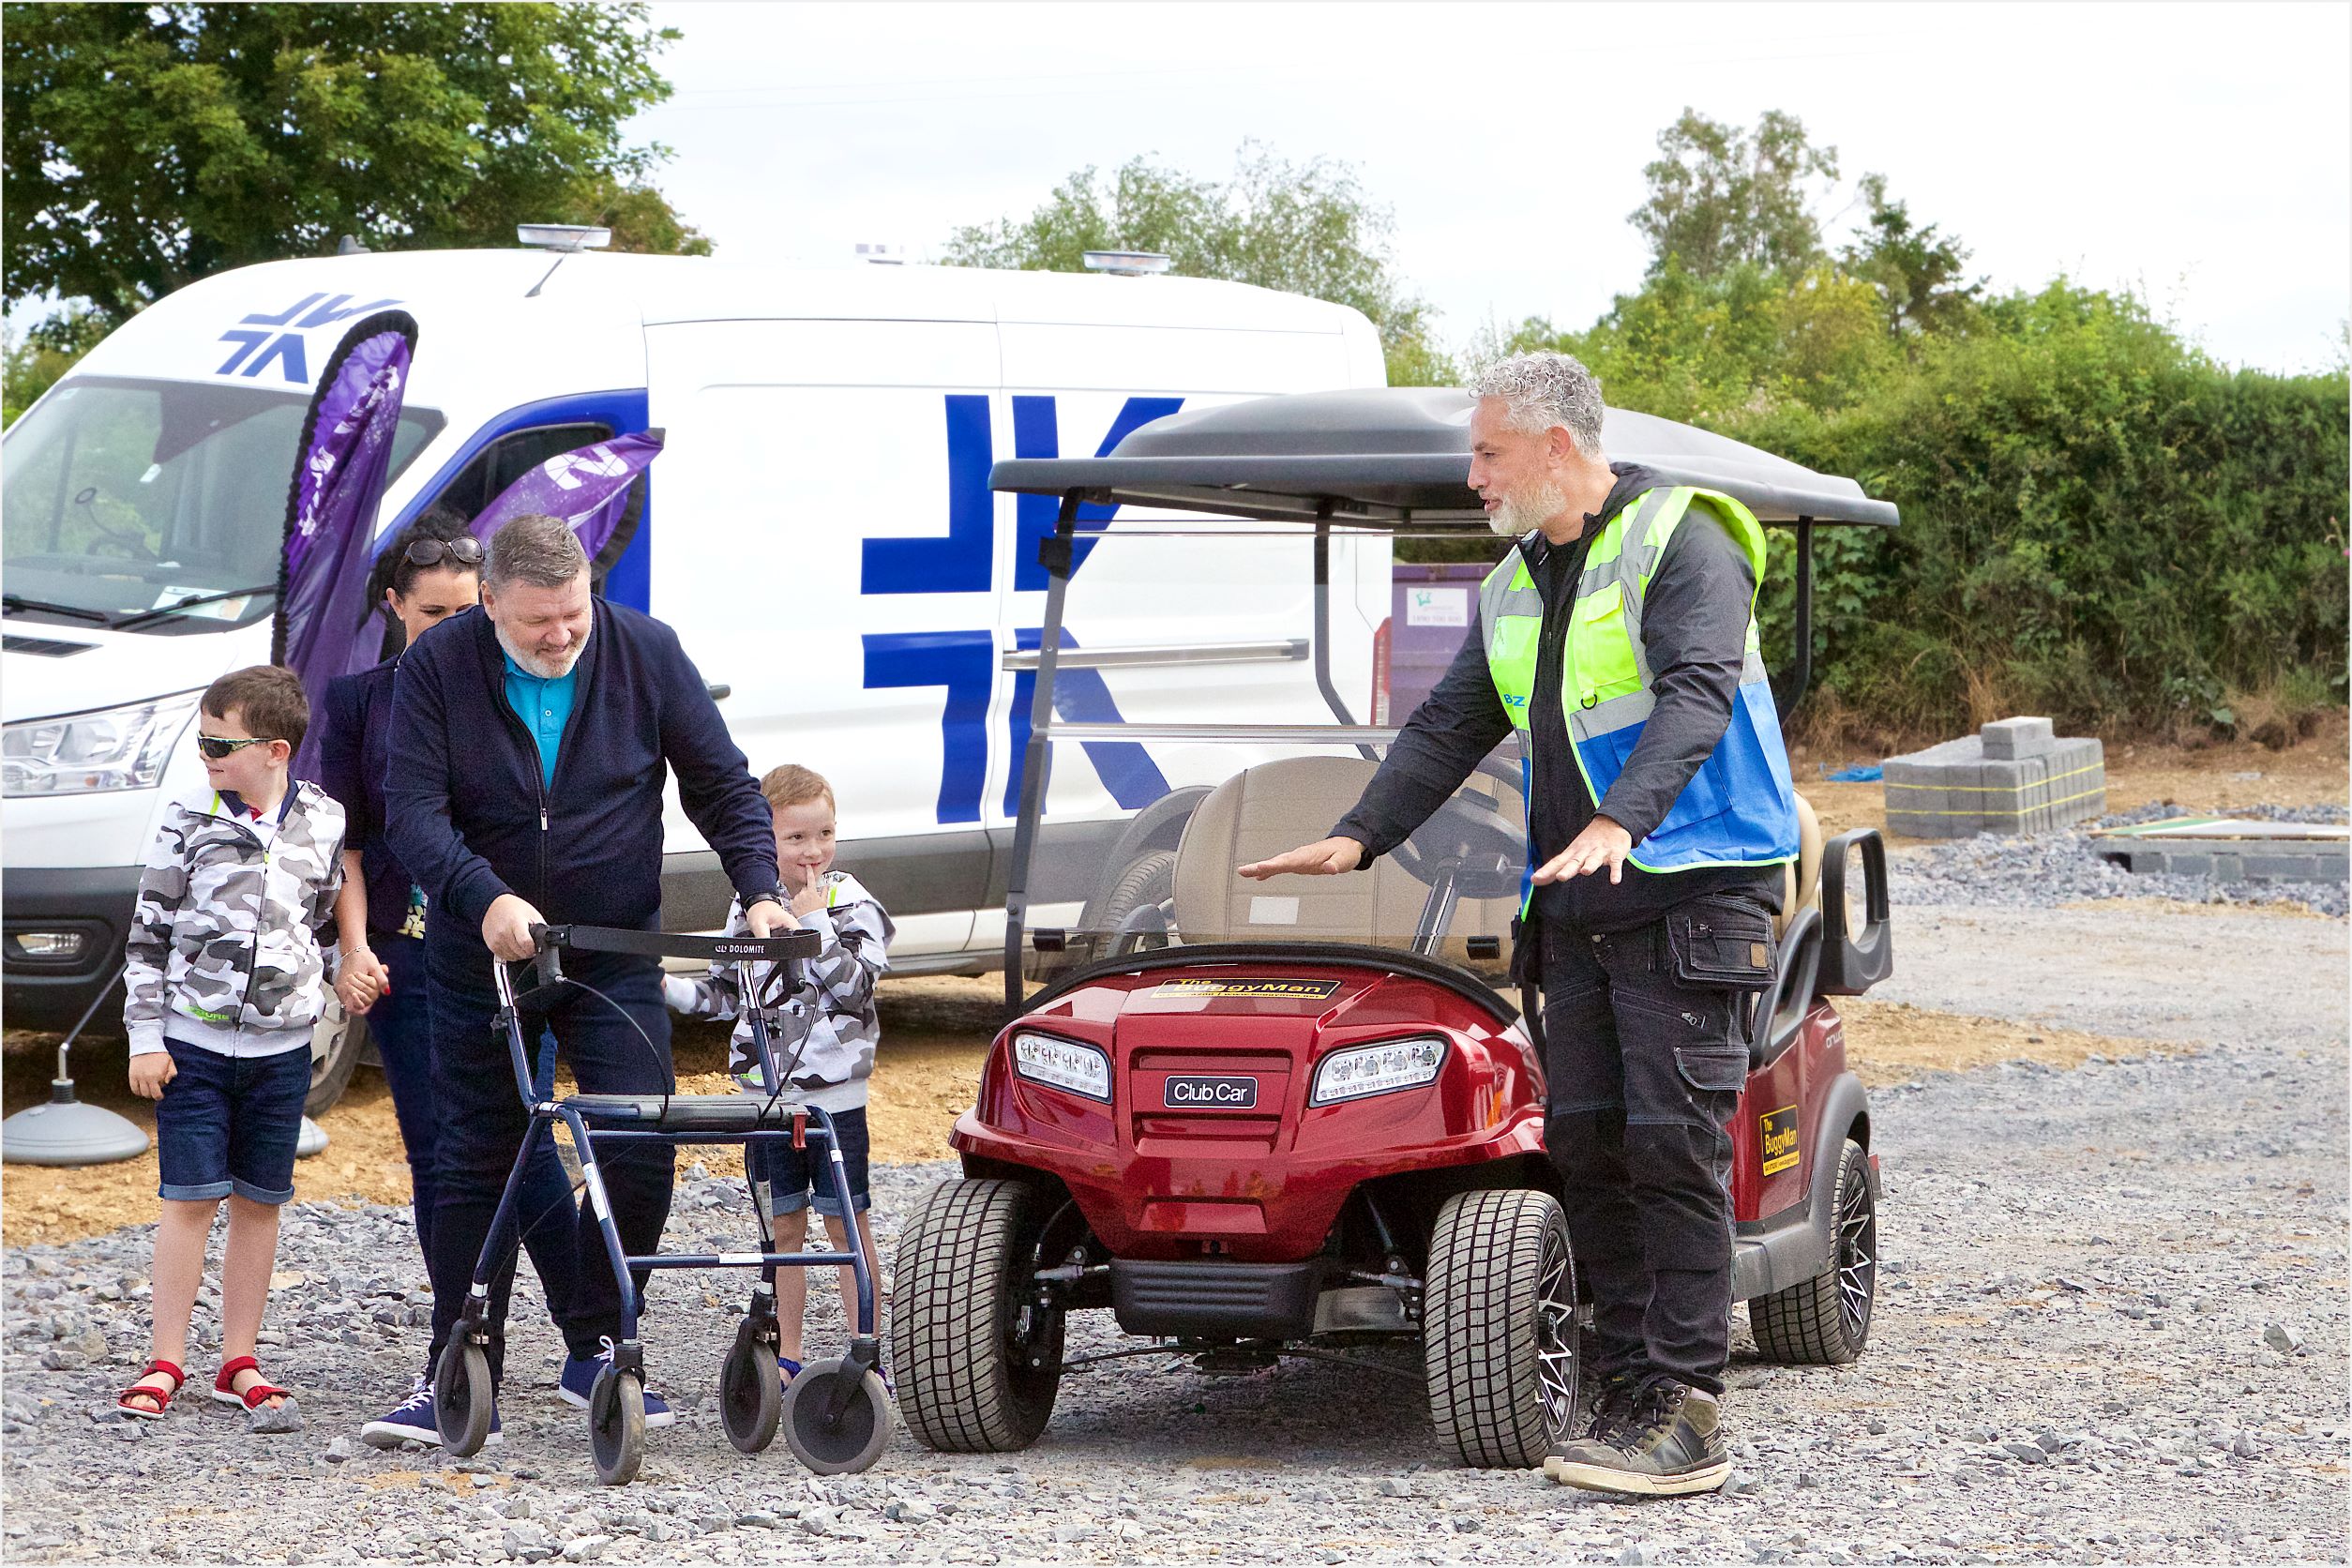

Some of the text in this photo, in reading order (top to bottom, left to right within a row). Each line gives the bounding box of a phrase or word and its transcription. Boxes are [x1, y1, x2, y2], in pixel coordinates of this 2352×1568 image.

[1174, 984, 1321, 993] BuggyMan
[1174, 1083, 1247, 1102] Club Car
[1764, 1119, 1772, 1132] The
[1765, 1128, 1797, 1155] BuggyMan
